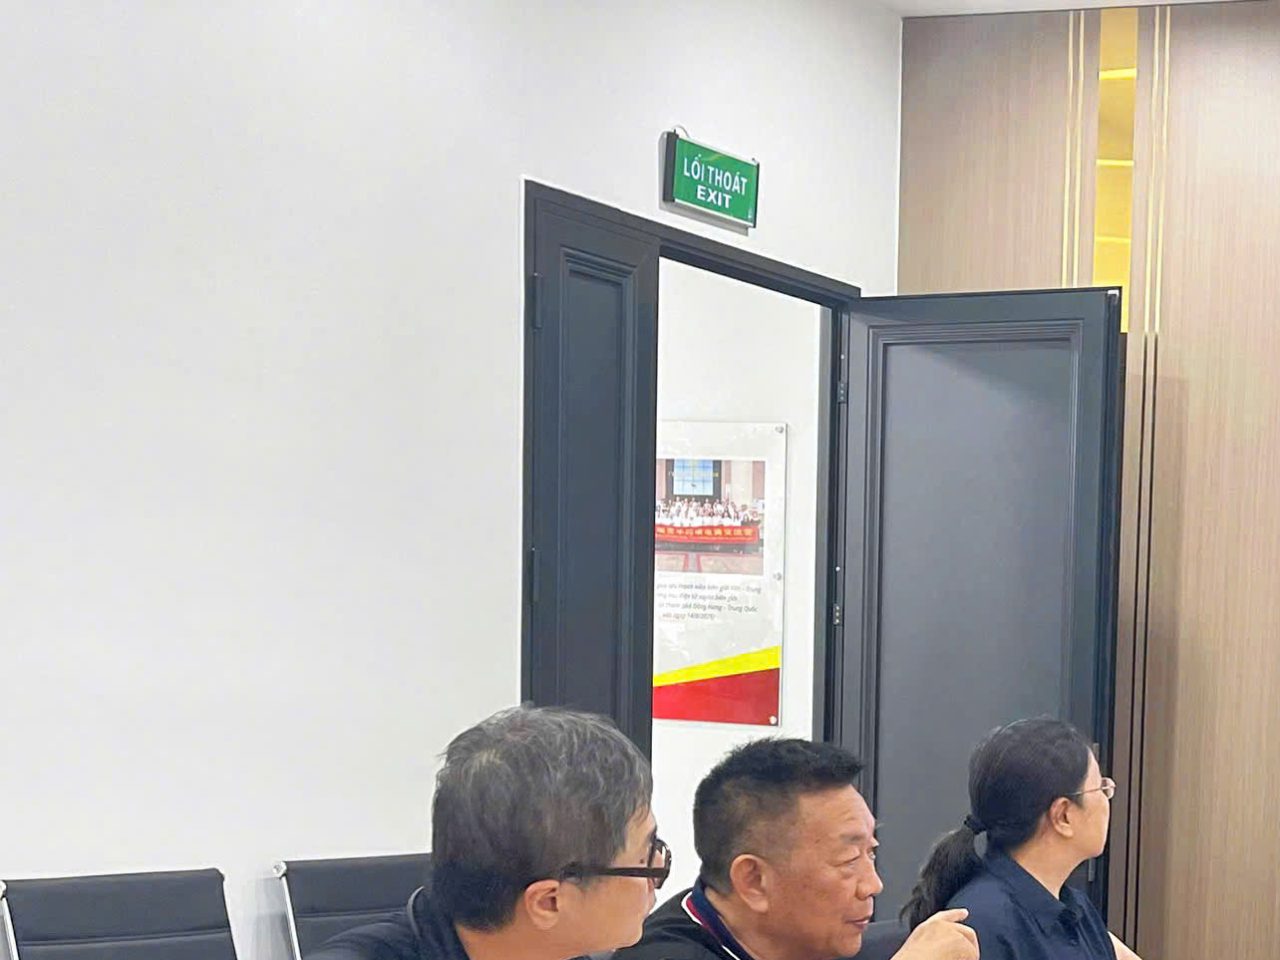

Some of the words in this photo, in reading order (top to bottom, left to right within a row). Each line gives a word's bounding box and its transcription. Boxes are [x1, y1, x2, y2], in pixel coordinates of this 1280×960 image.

[683, 153, 705, 182] LỐI
[707, 165, 748, 196] THOÁT
[696, 184, 732, 208] EXIT
